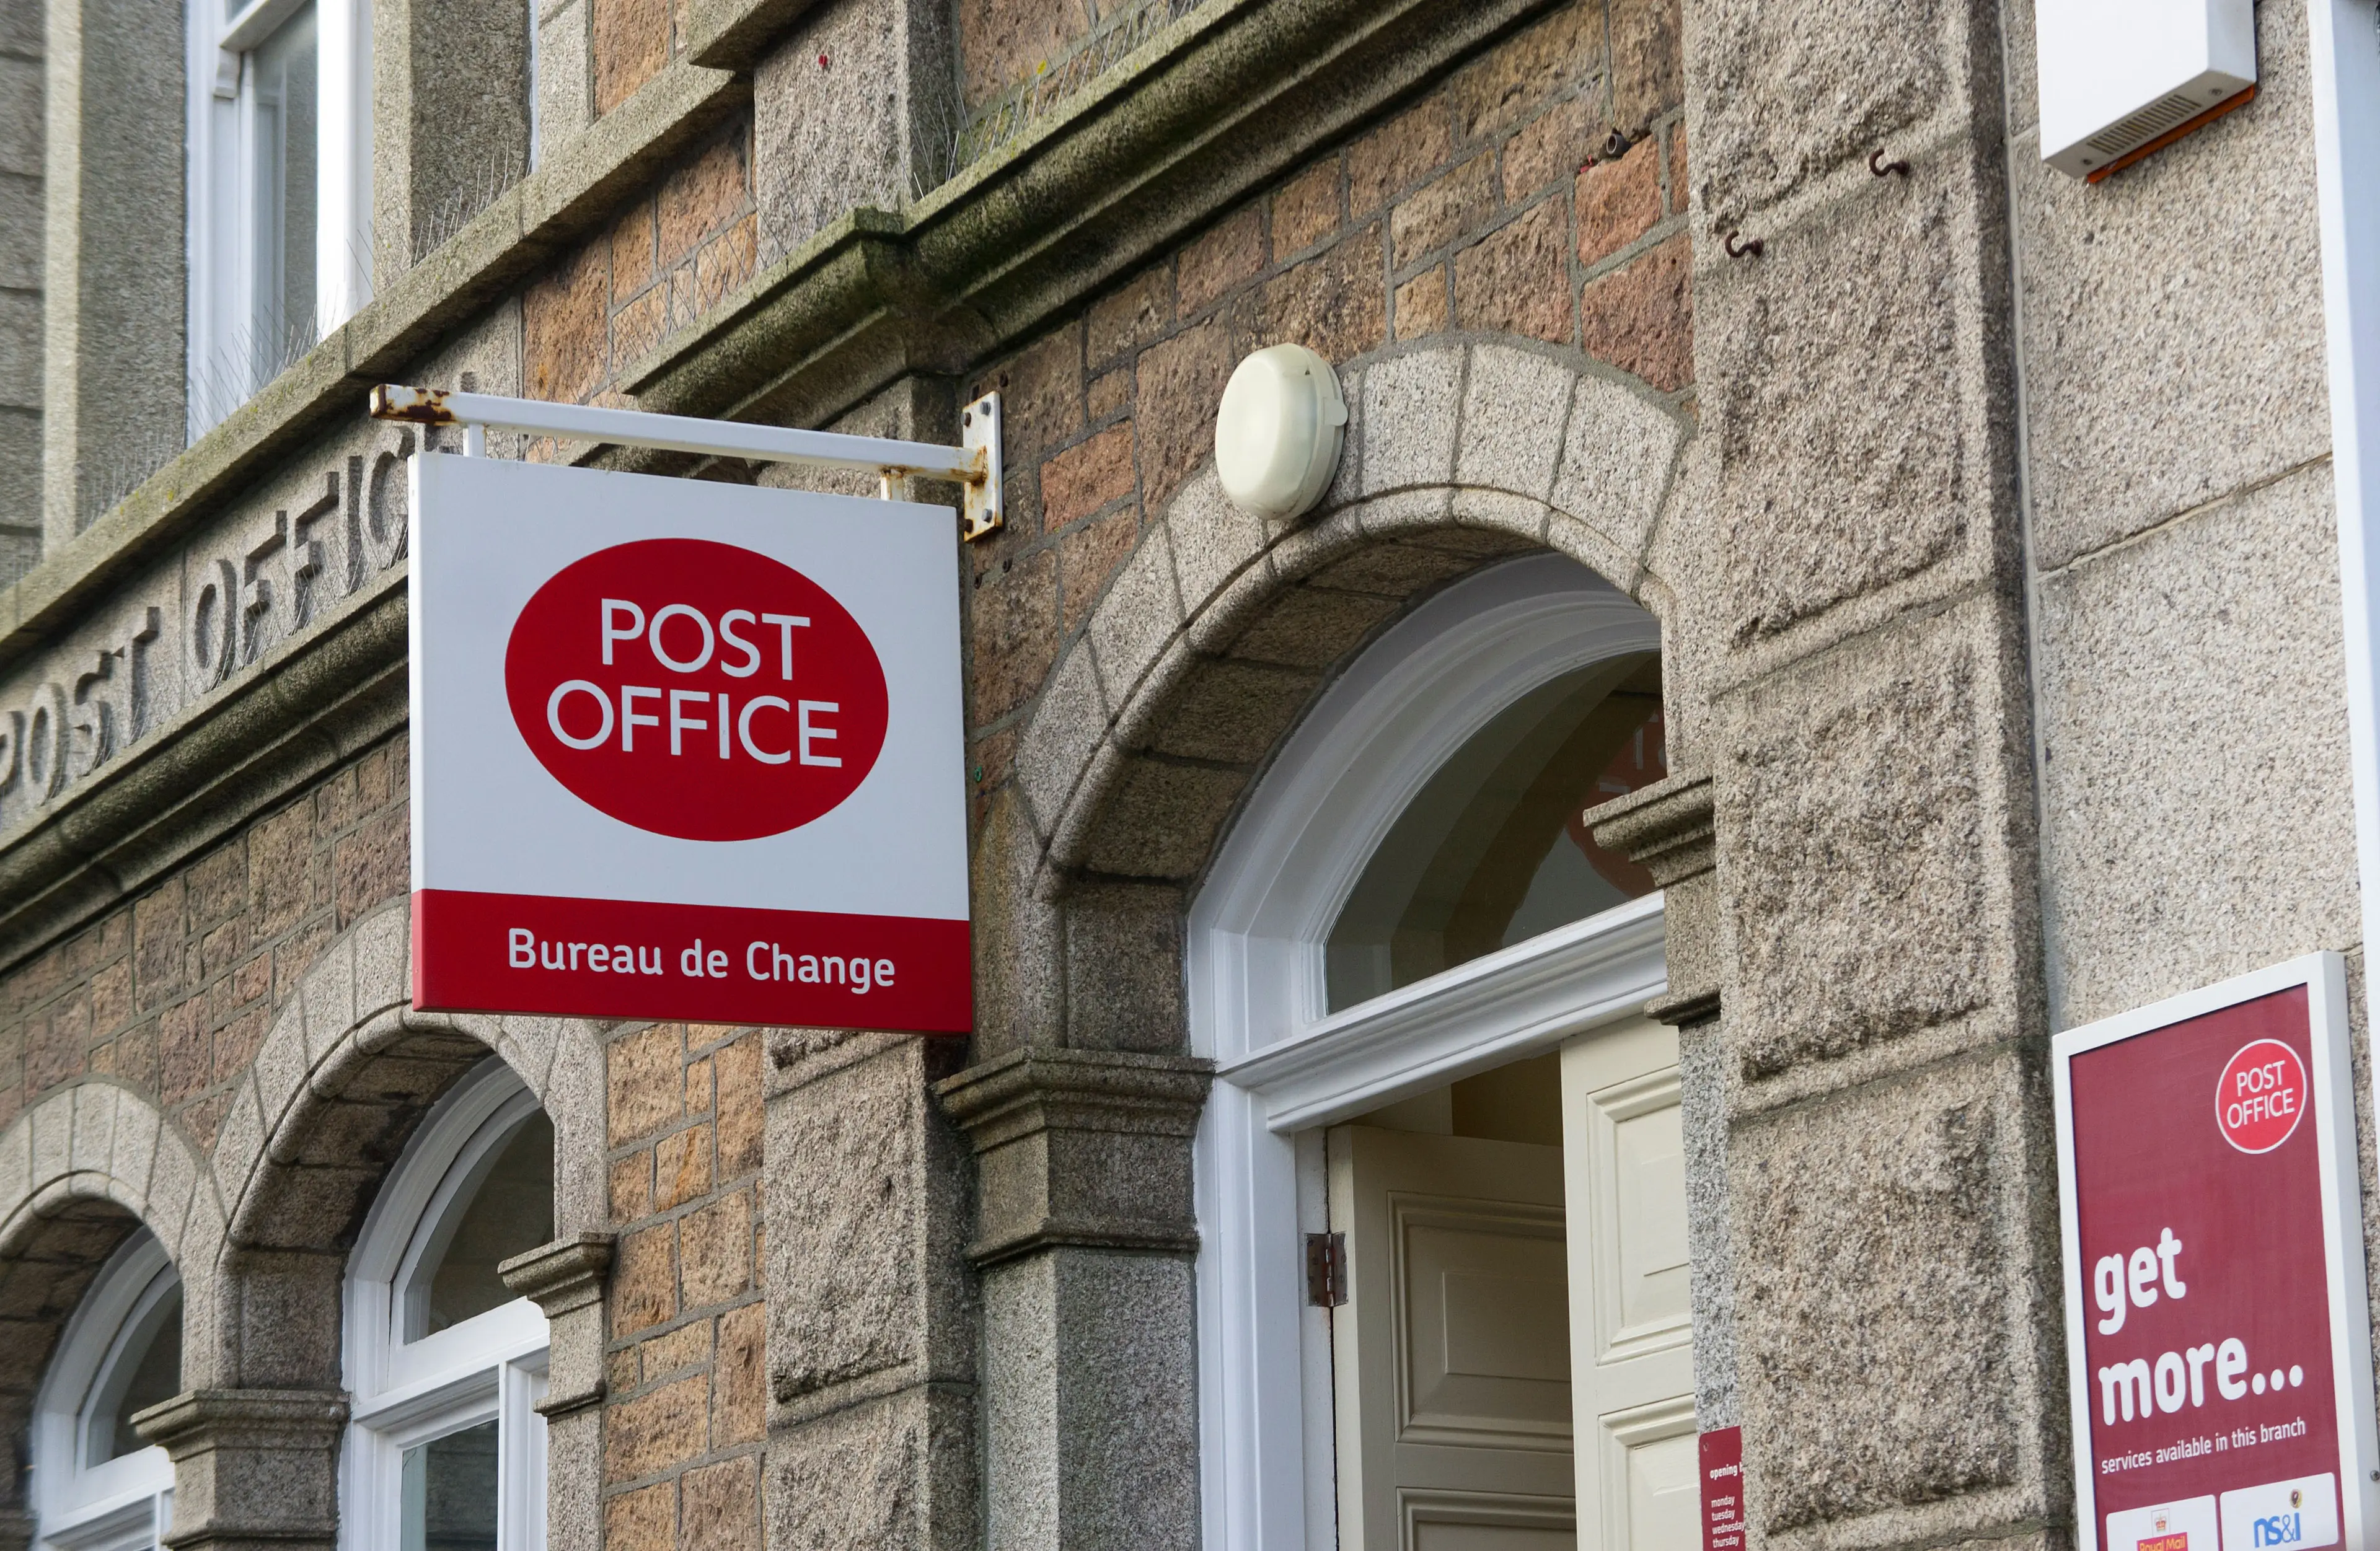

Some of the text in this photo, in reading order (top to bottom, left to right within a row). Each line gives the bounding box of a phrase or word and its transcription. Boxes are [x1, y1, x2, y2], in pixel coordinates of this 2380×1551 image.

[190, 372, 476, 694] OFFIC
[601, 597, 811, 680] POST
[547, 679, 842, 768] OFFICE
[508, 928, 895, 995] Bureau de Change
[2236, 1060, 2285, 1097] POST
[2227, 1087, 2295, 1128] OFFICE
[2094, 1227, 2187, 1335] get
[2097, 1337, 2304, 1426] more...
[2101, 1416, 2306, 1474] services available in this branch
[1709, 1464, 1738, 1480] opening
[1711, 1495, 1735, 1508] monday
[1711, 1508, 1735, 1521] tuesday
[1712, 1520, 1745, 1534] wednesday
[1712, 1535, 1740, 1548] thursday
[2140, 1536, 2185, 1551] Royal Mail
